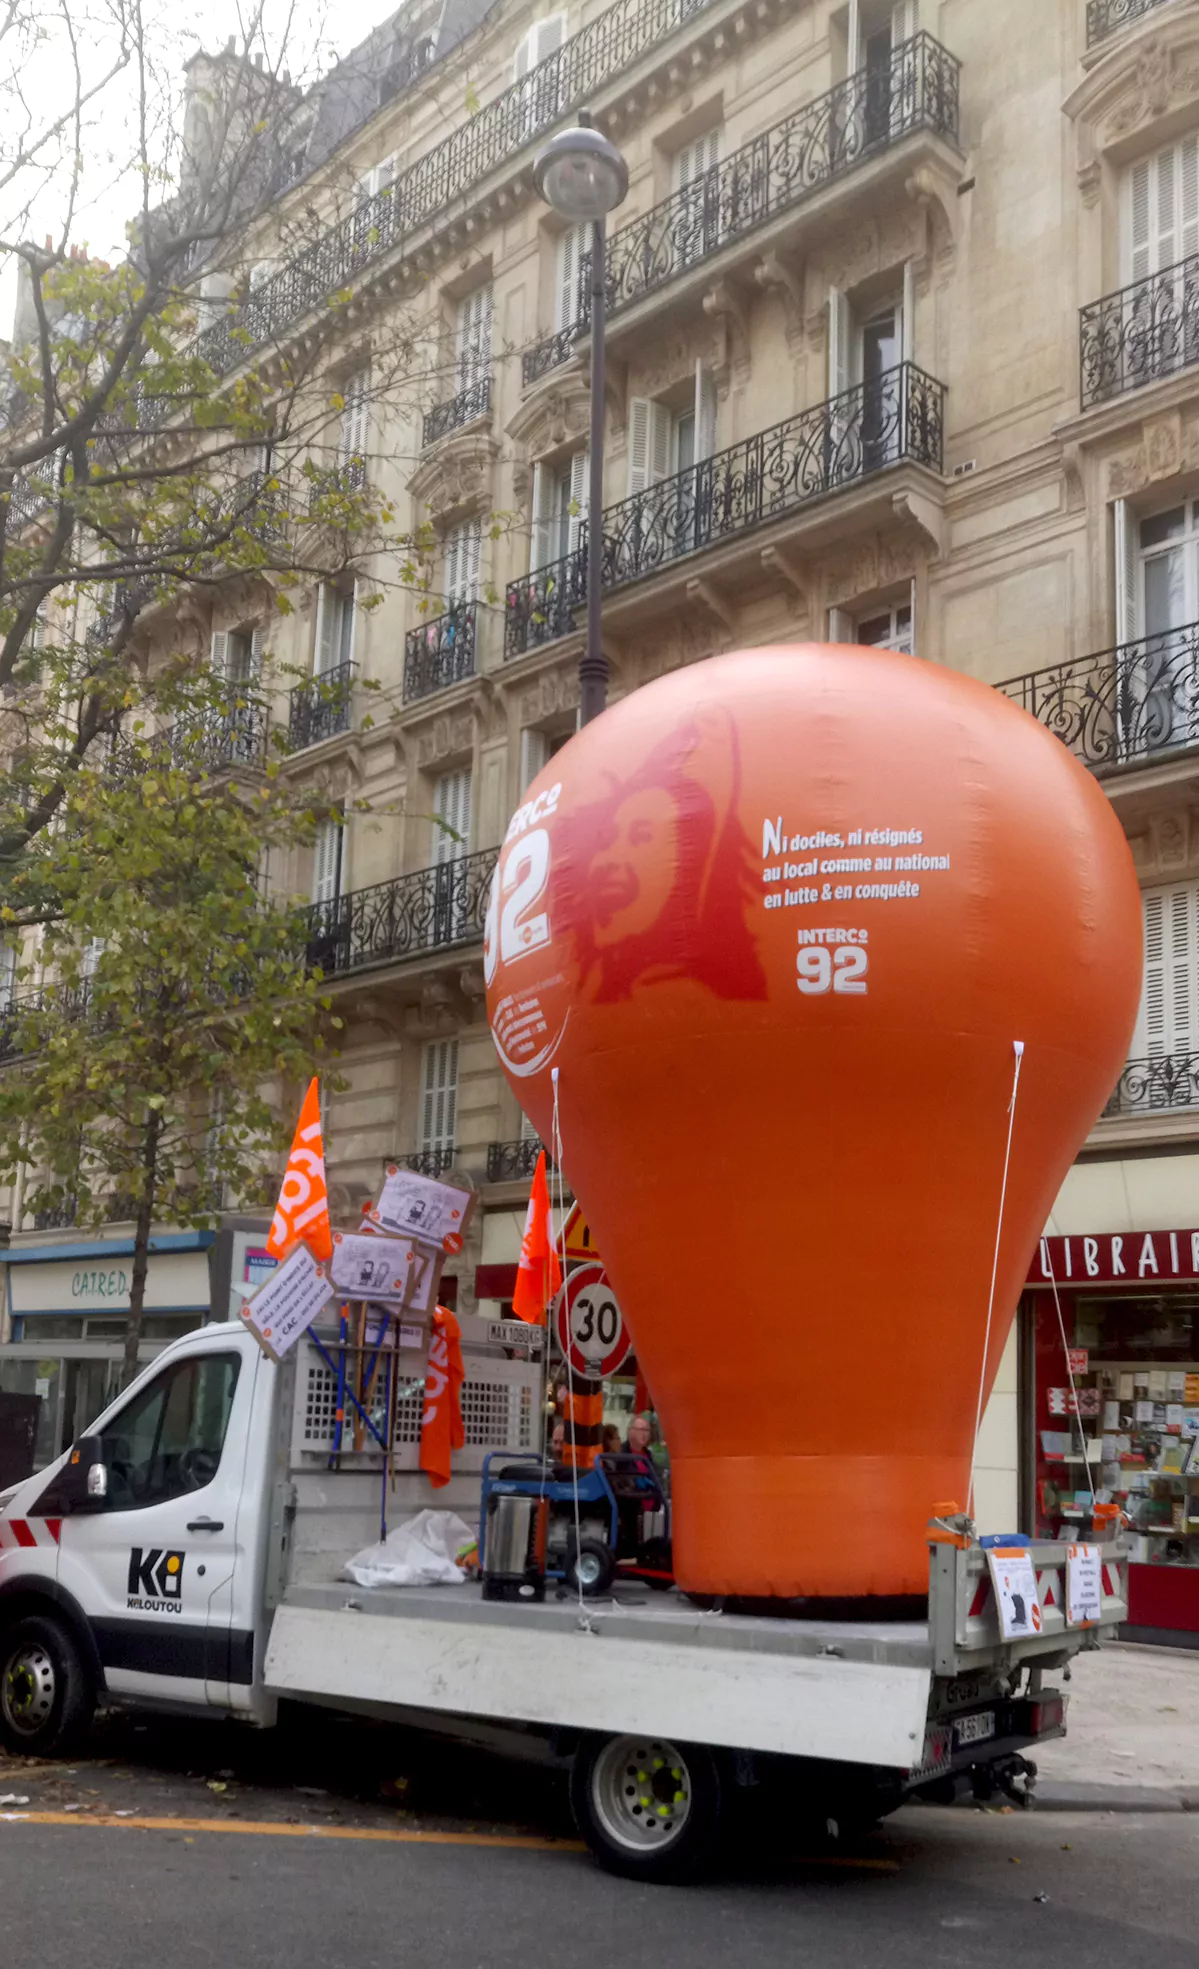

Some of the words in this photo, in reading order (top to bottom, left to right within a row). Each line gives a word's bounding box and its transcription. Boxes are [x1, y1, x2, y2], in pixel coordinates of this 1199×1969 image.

[763, 815, 788, 859] Ni
[791, 831, 845, 851] dociles,
[848, 829, 862, 846] ni
[864, 828, 923, 847] résignés
[763, 866, 780, 882] au
[784, 858, 818, 879] local
[820, 858, 872, 874] comme
[874, 856, 892, 871] au
[895, 853, 950, 870] national
[764, 893, 781, 909] en
[784, 887, 819, 906] lutte
[821, 883, 832, 901] &
[835, 885, 852, 900] en
[855, 881, 920, 900] conquête
[796, 946, 869, 995] 92
[281, 1316, 299, 1336] CAC
[491, 1324, 507, 1341] MAX
[576, 1298, 618, 1345] 30
